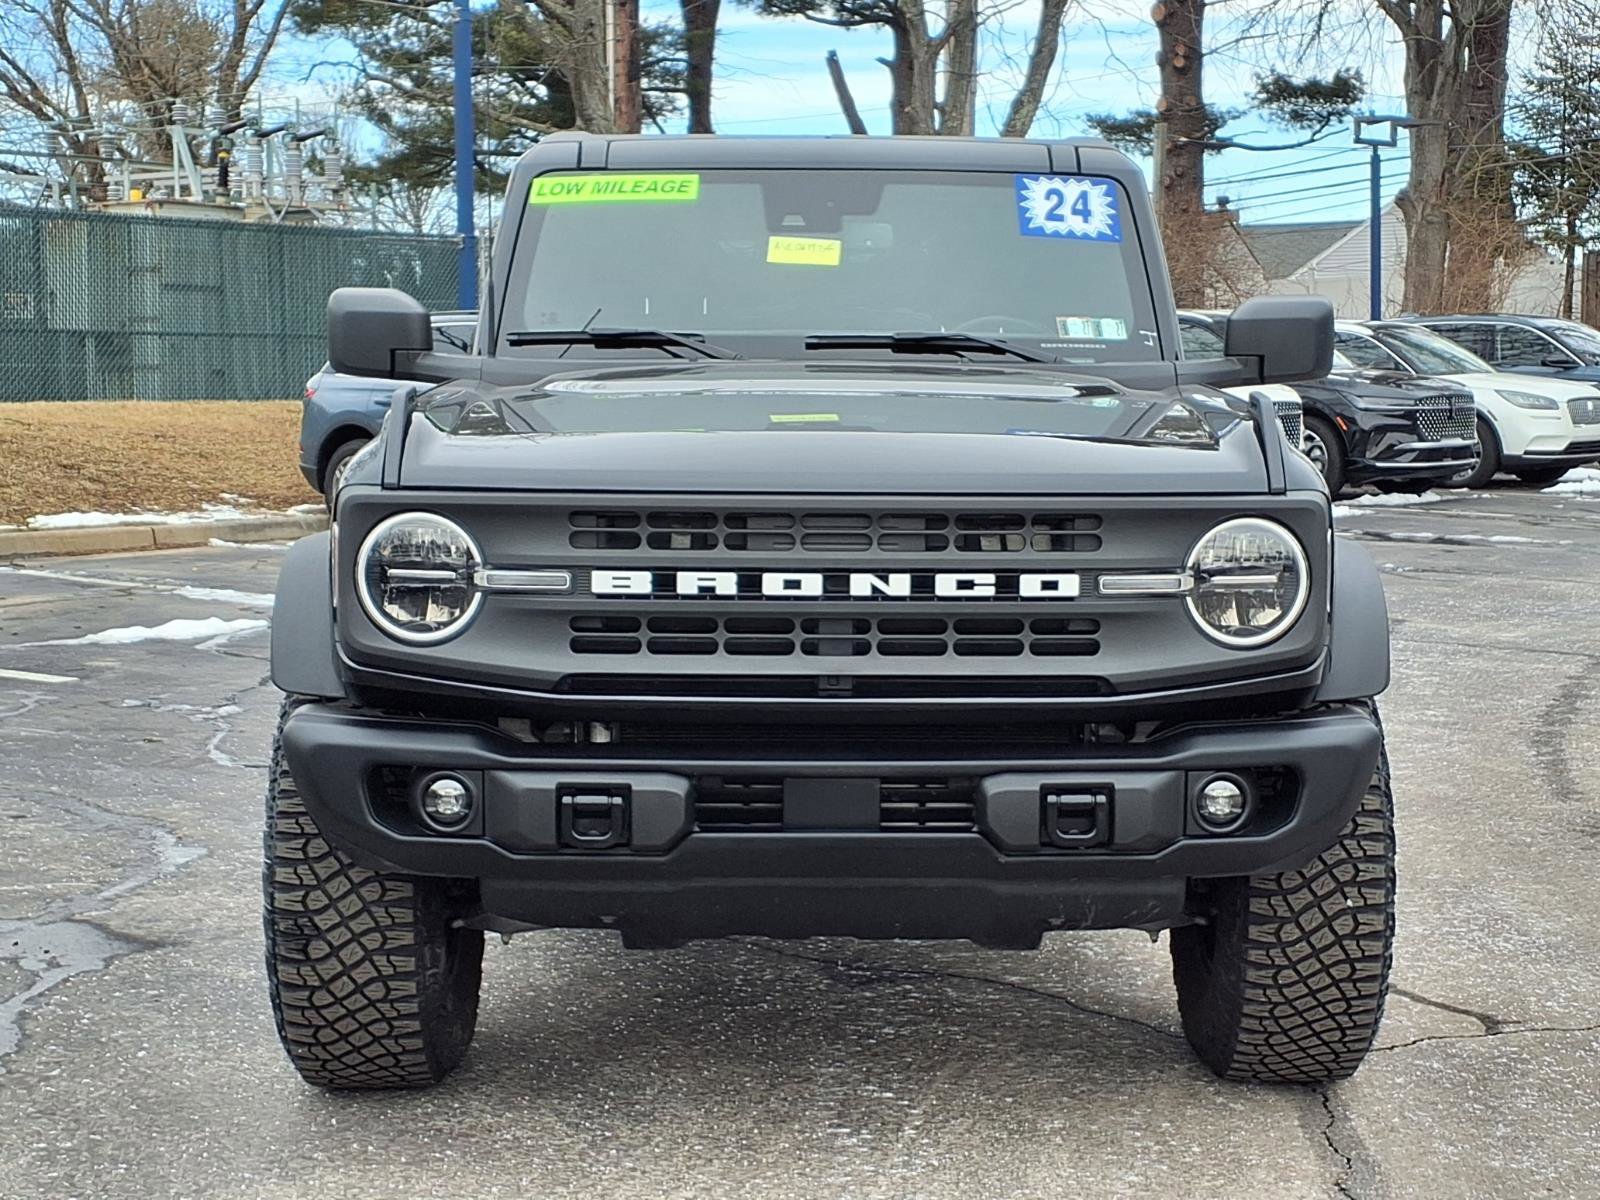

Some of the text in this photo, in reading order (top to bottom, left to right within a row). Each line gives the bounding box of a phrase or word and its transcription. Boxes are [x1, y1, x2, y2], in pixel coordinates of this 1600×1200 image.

[536, 179, 693, 196] LOW MILEAGE
[1043, 187, 1092, 224] 24
[591, 569, 1080, 597] BRONCO
